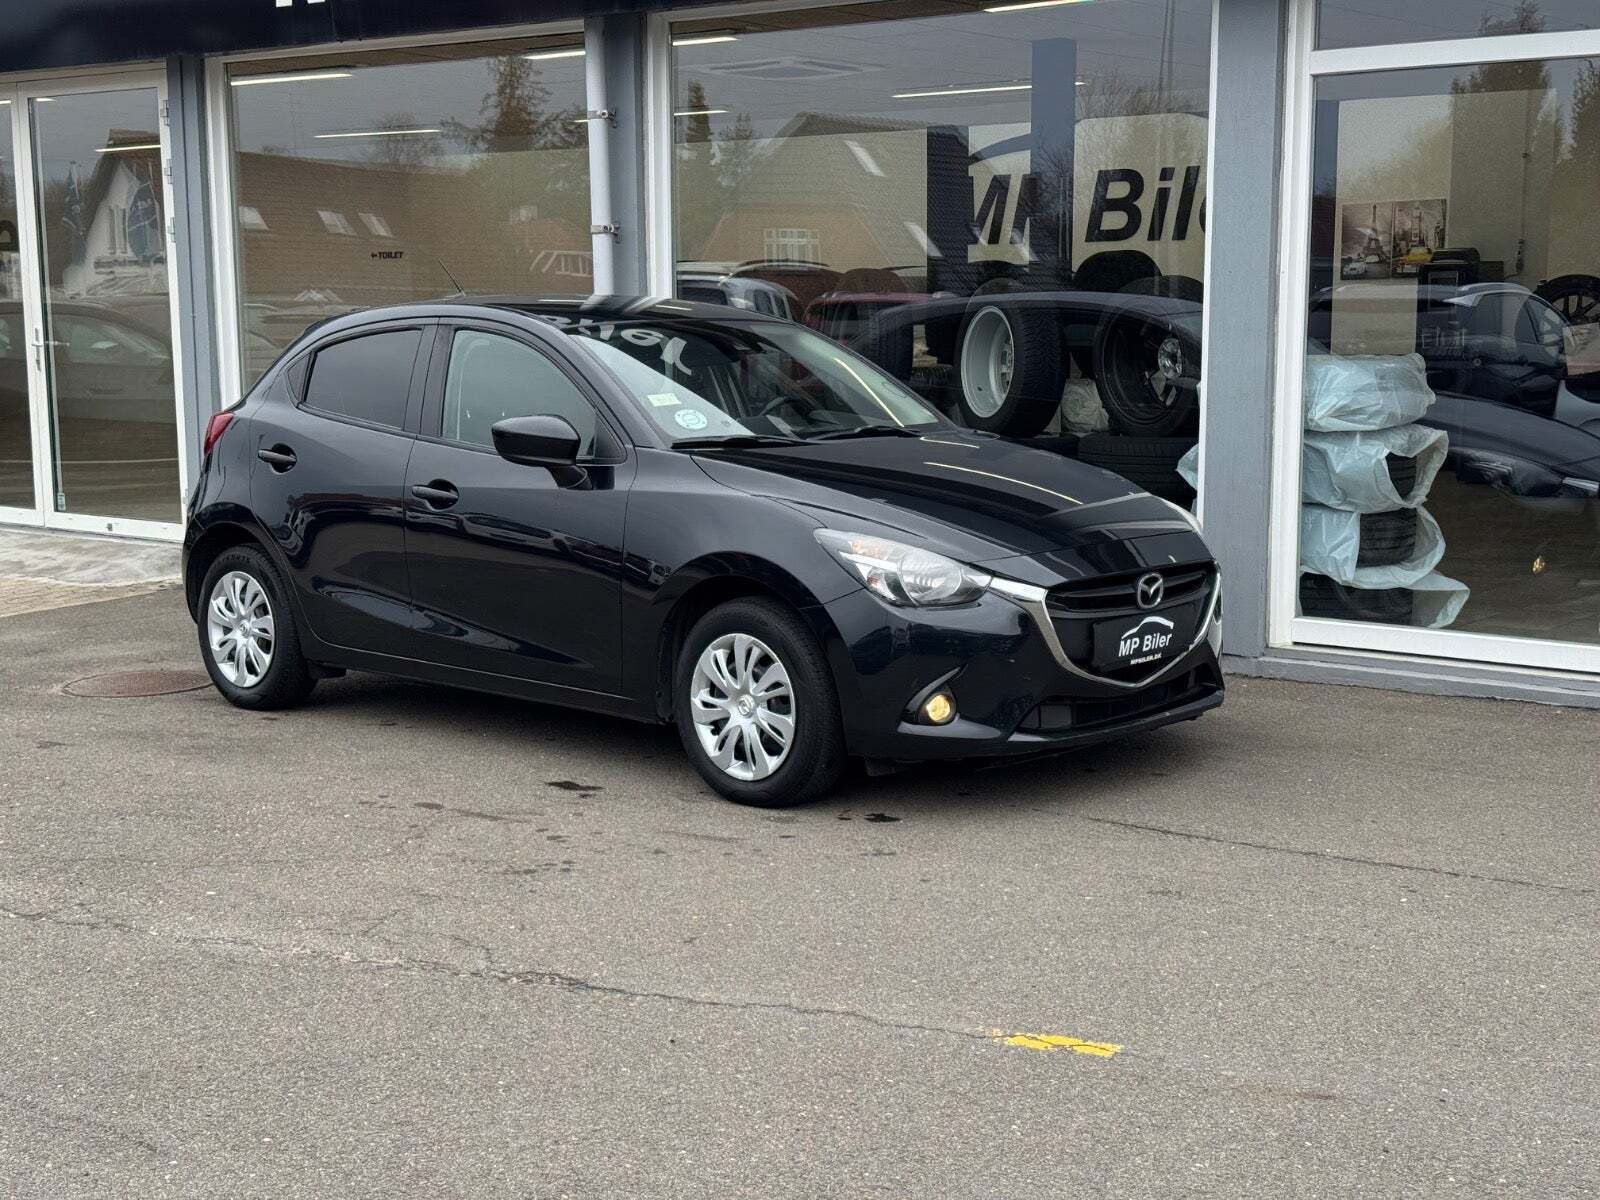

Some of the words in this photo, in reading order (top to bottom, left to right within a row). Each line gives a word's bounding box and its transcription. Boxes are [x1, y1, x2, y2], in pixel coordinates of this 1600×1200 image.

[1085, 165, 1207, 243] Bil
[378, 251, 404, 259] TOILET
[1118, 637, 1140, 657] MP
[1142, 632, 1172, 652] Biler
